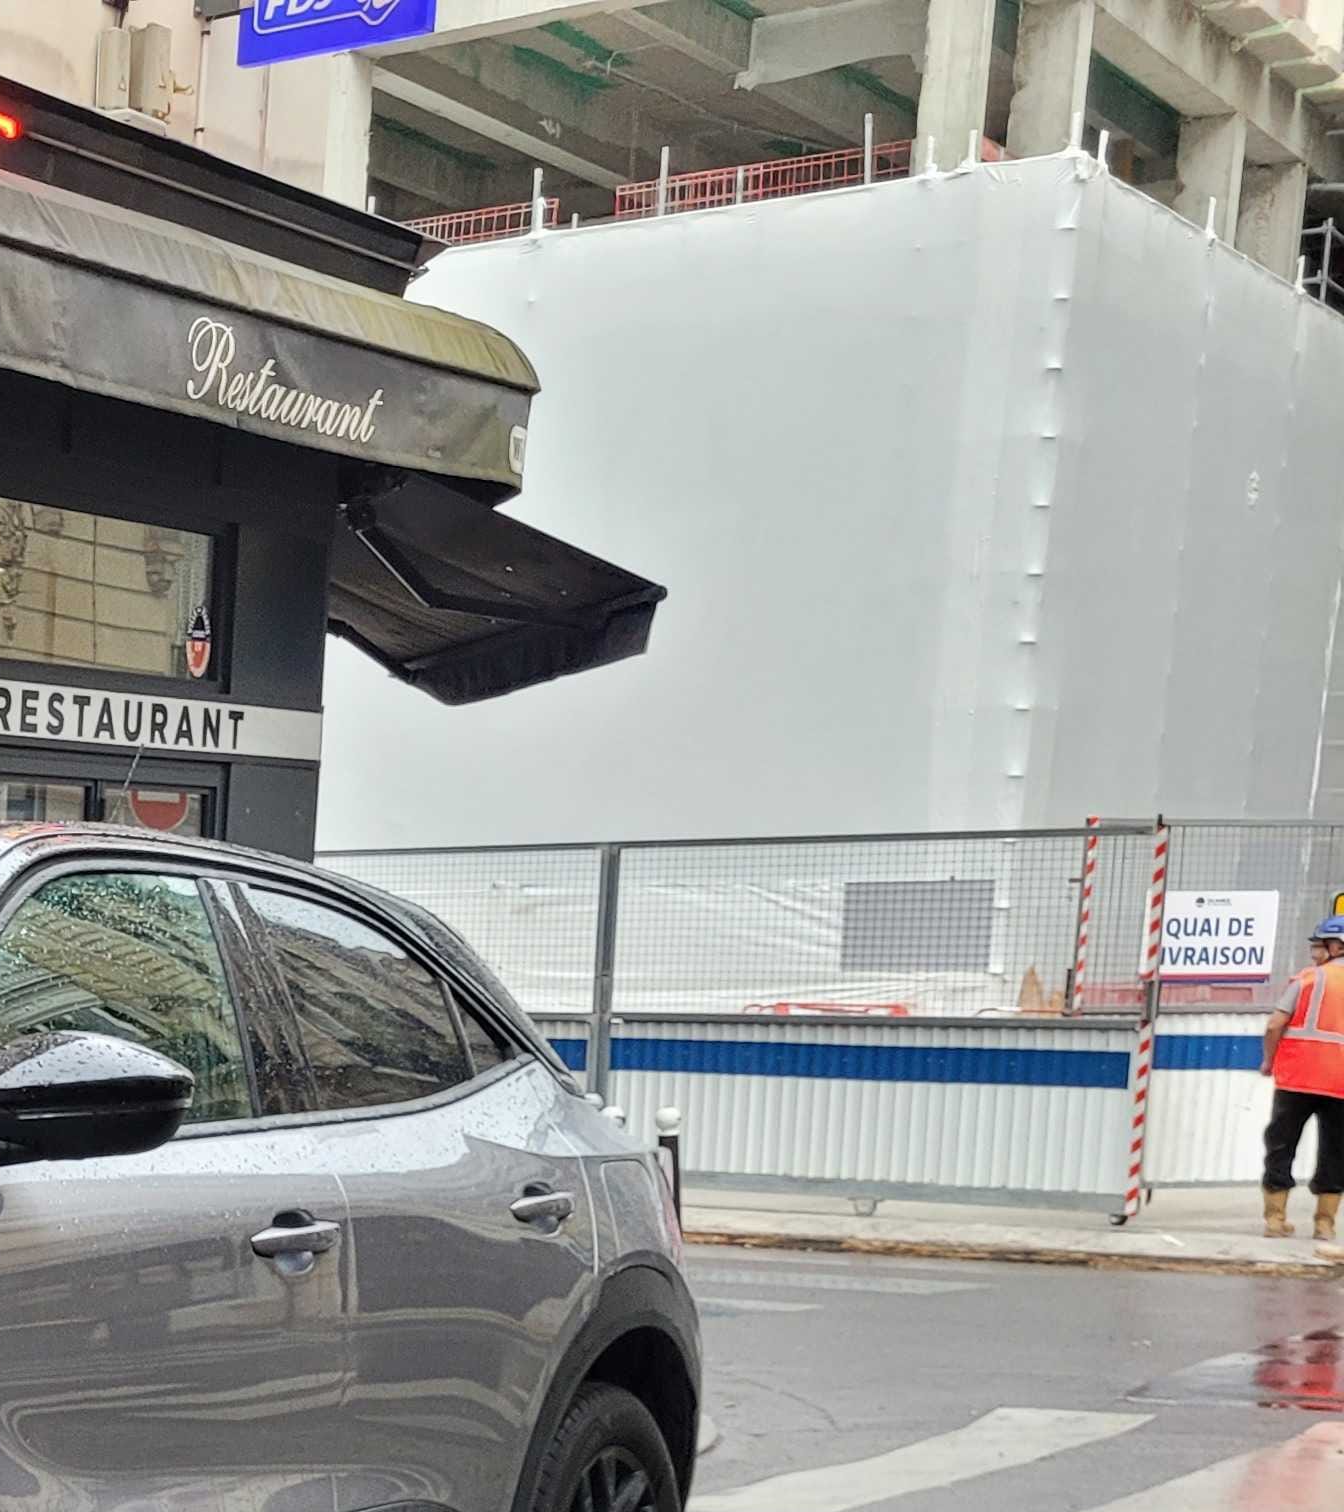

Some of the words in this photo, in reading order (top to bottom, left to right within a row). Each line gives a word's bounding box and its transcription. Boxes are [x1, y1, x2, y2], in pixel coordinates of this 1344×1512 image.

[186, 316, 385, 443] Restaurant
[1165, 917, 1220, 940] QUAI
[1228, 917, 1256, 937] DE
[1159, 946, 1265, 967] IVRAISON
